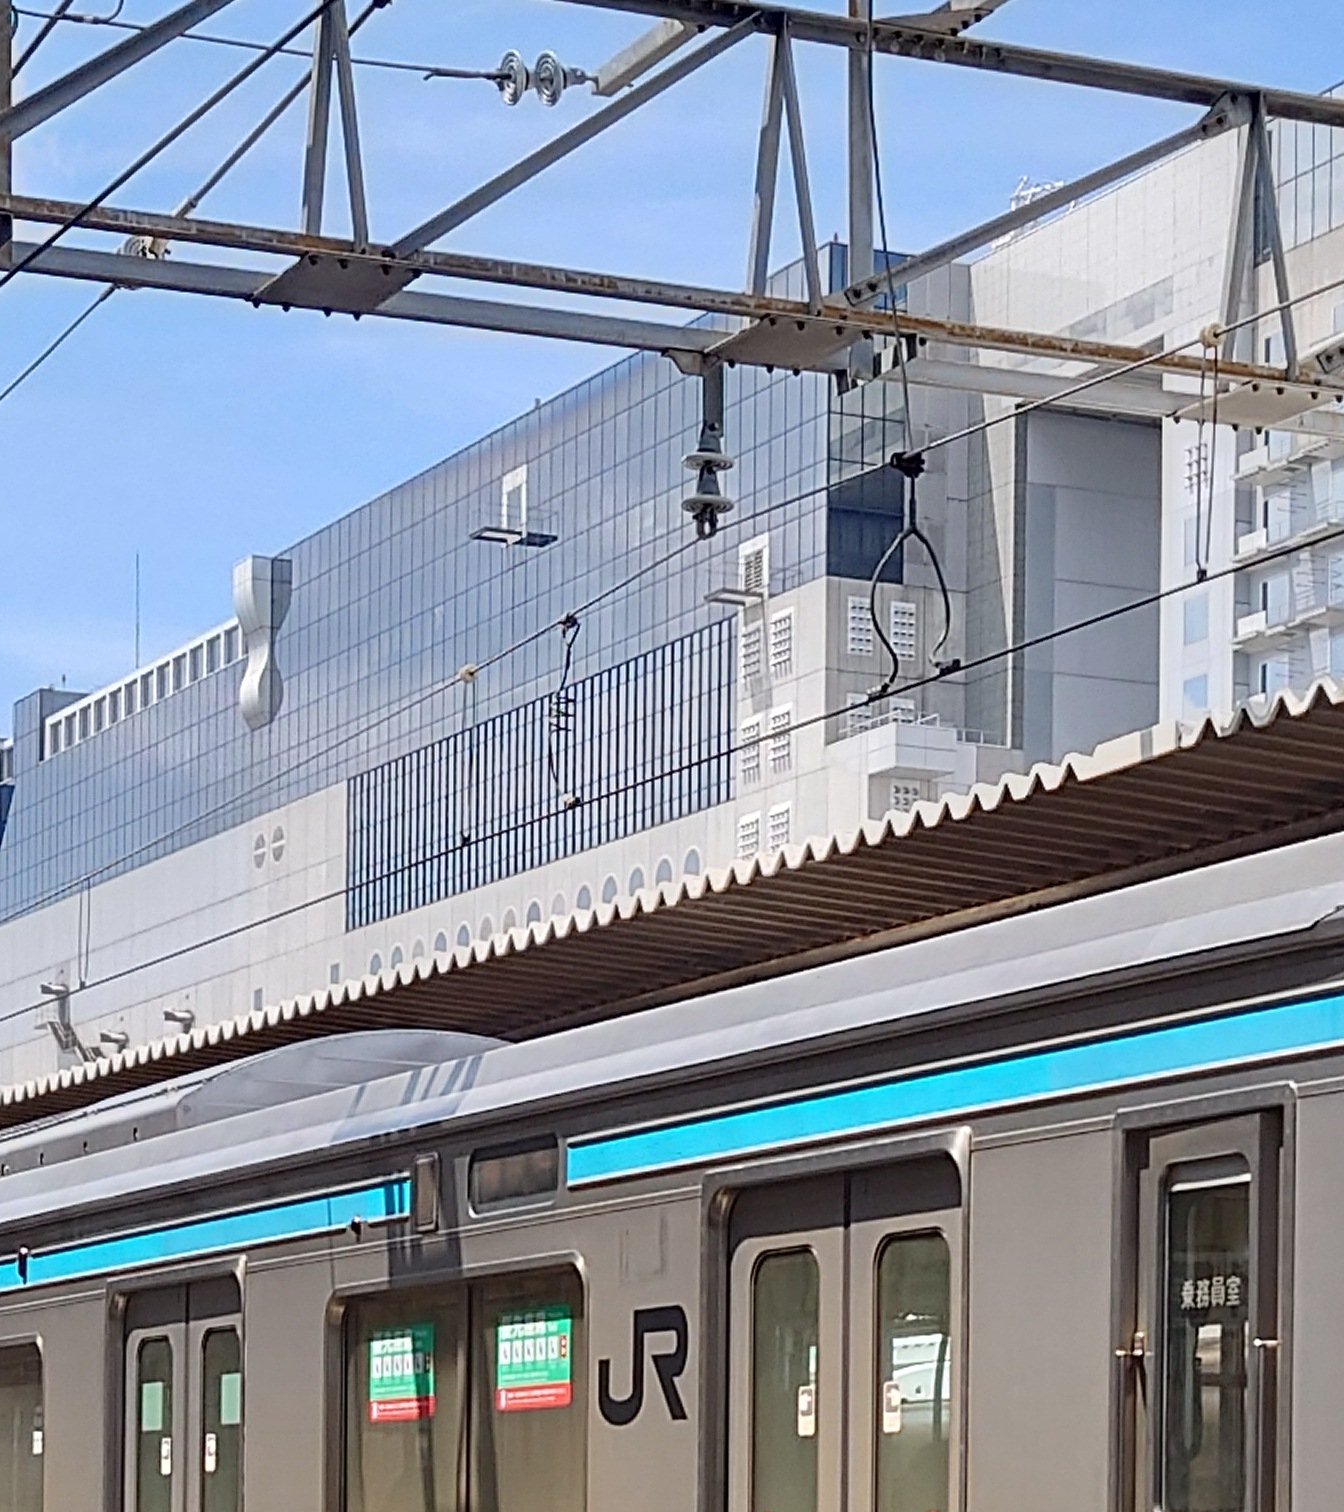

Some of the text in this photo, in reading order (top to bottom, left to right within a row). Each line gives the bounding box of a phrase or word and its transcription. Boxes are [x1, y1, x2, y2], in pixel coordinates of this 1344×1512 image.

[1180, 1275, 1242, 1310] 乗務員室
[598, 1305, 689, 1427] JR
